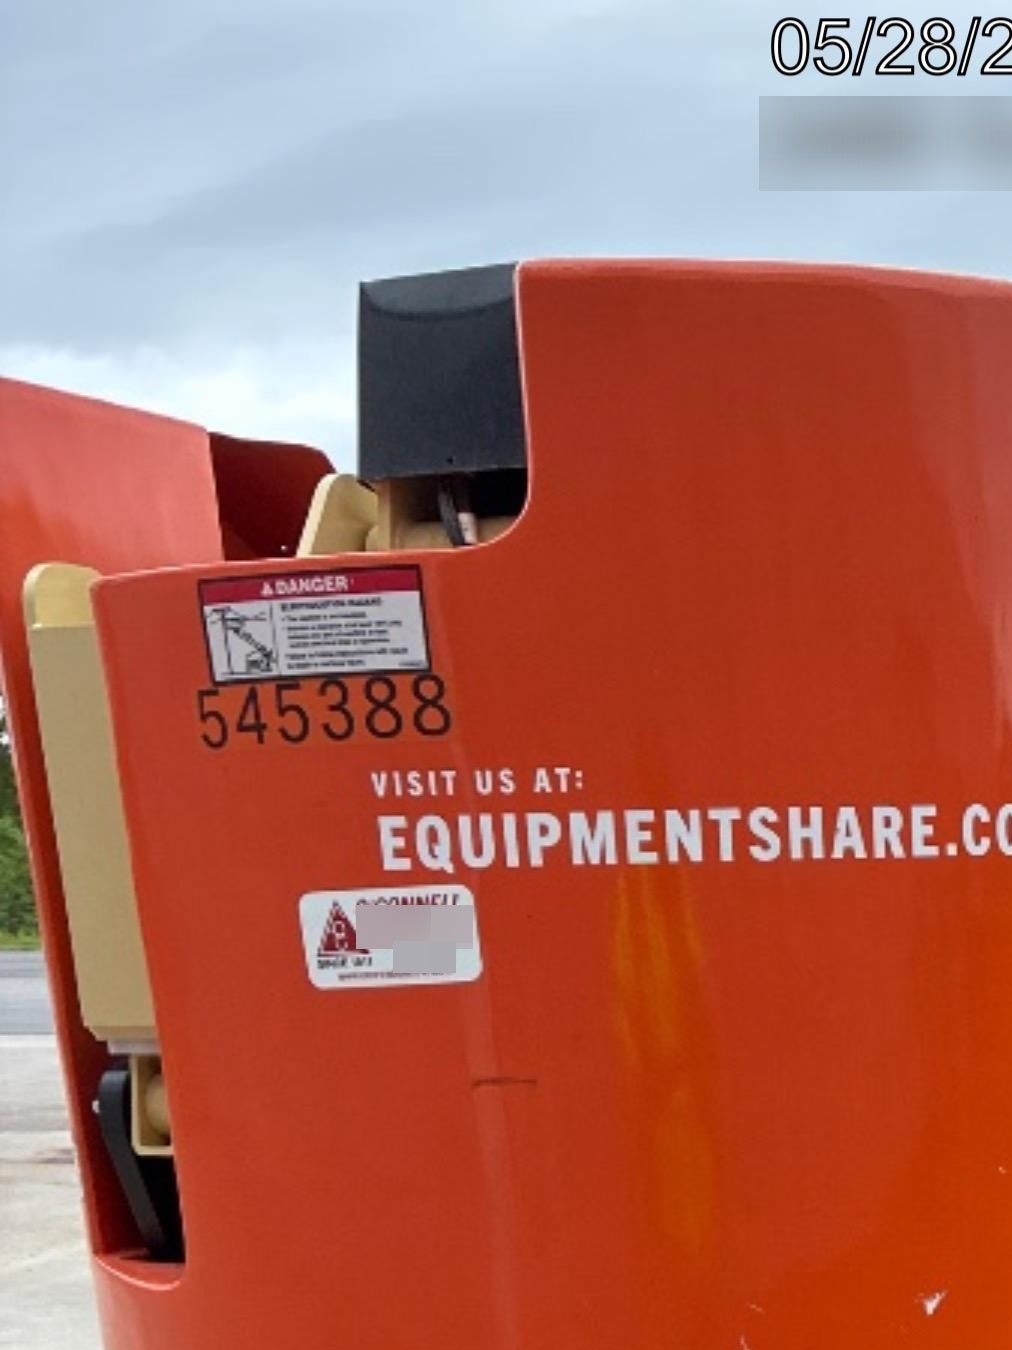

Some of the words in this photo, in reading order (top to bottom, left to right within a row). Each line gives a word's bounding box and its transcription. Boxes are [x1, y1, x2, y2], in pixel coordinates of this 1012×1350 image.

[275, 576, 349, 596] DANGER
[197, 675, 452, 748] 545388
[371, 771, 457, 799] VISIT
[476, 769, 516, 796] US
[533, 767, 584, 795] AT:
